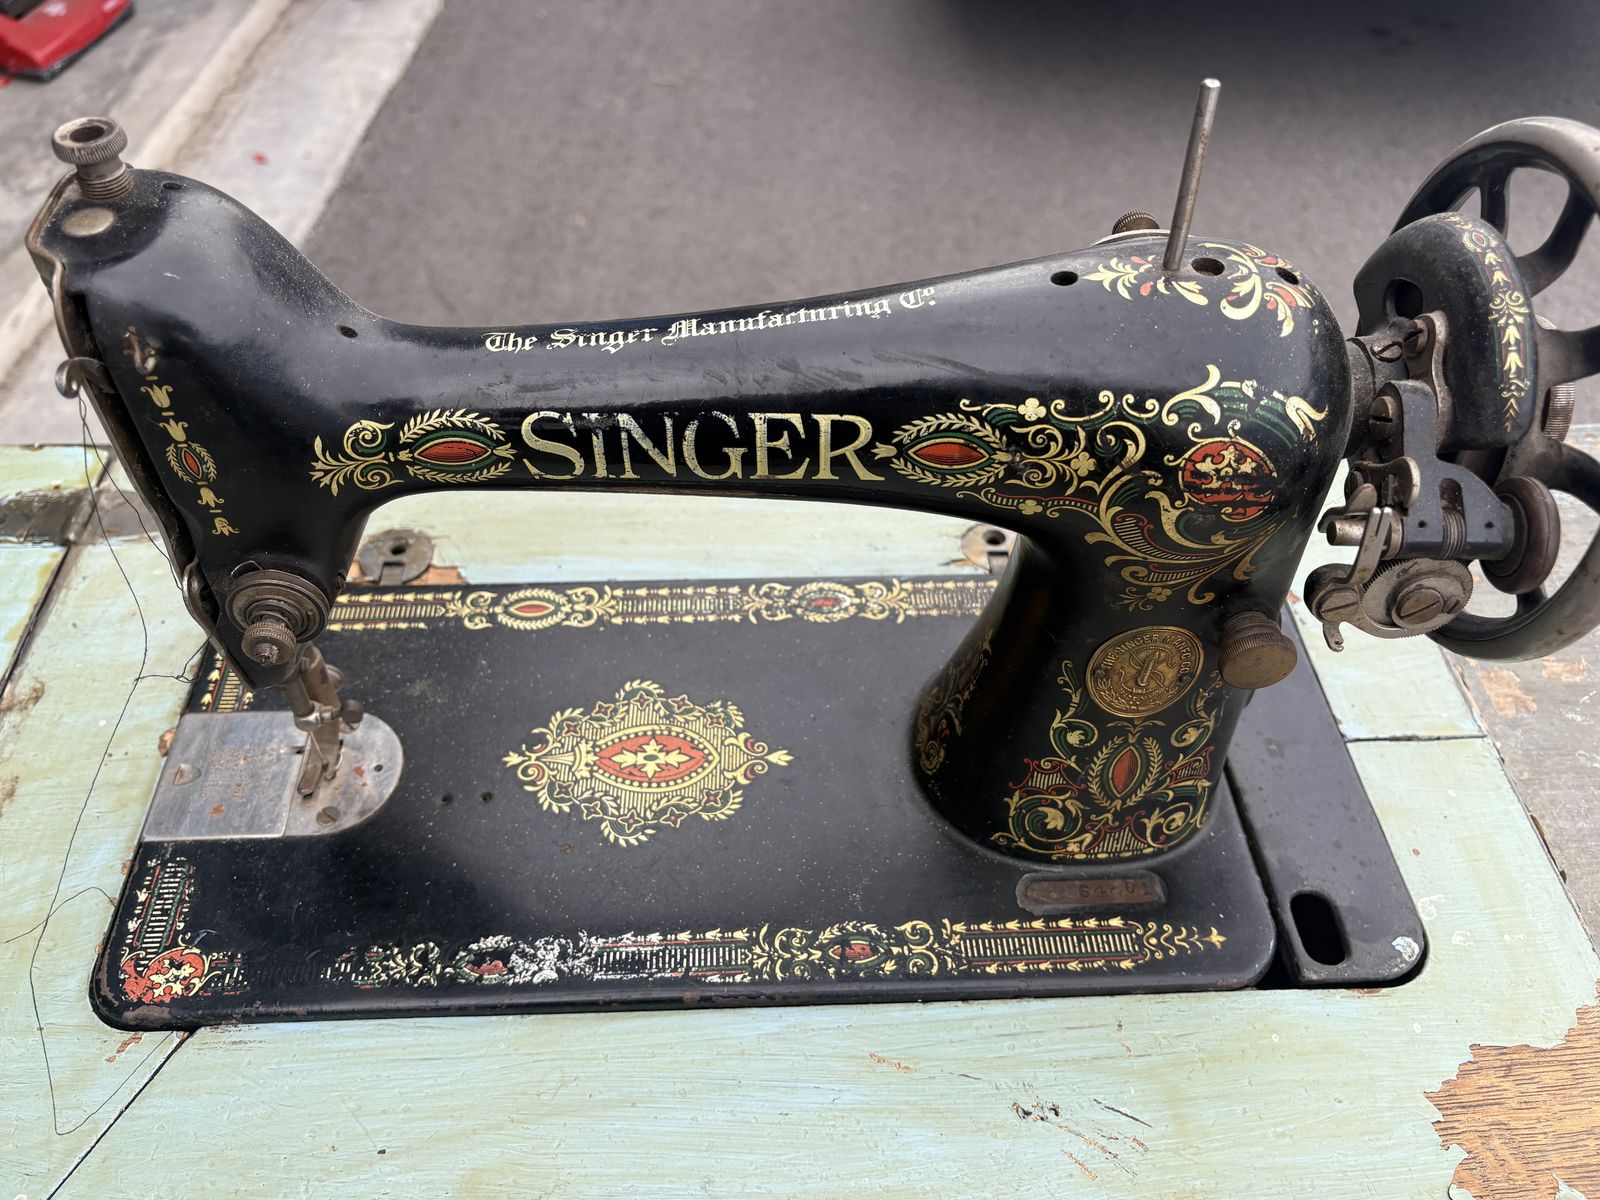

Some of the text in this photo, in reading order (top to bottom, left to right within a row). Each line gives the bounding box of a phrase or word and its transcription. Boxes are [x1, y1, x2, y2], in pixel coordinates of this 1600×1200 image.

[481, 332, 538, 353] The
[546, 328, 658, 354] Singer
[661, 297, 891, 346] Manufacturing
[520, 410, 886, 481] SINGER
[1101, 652, 1117, 669] THE
[1115, 634, 1160, 655] SINGER
